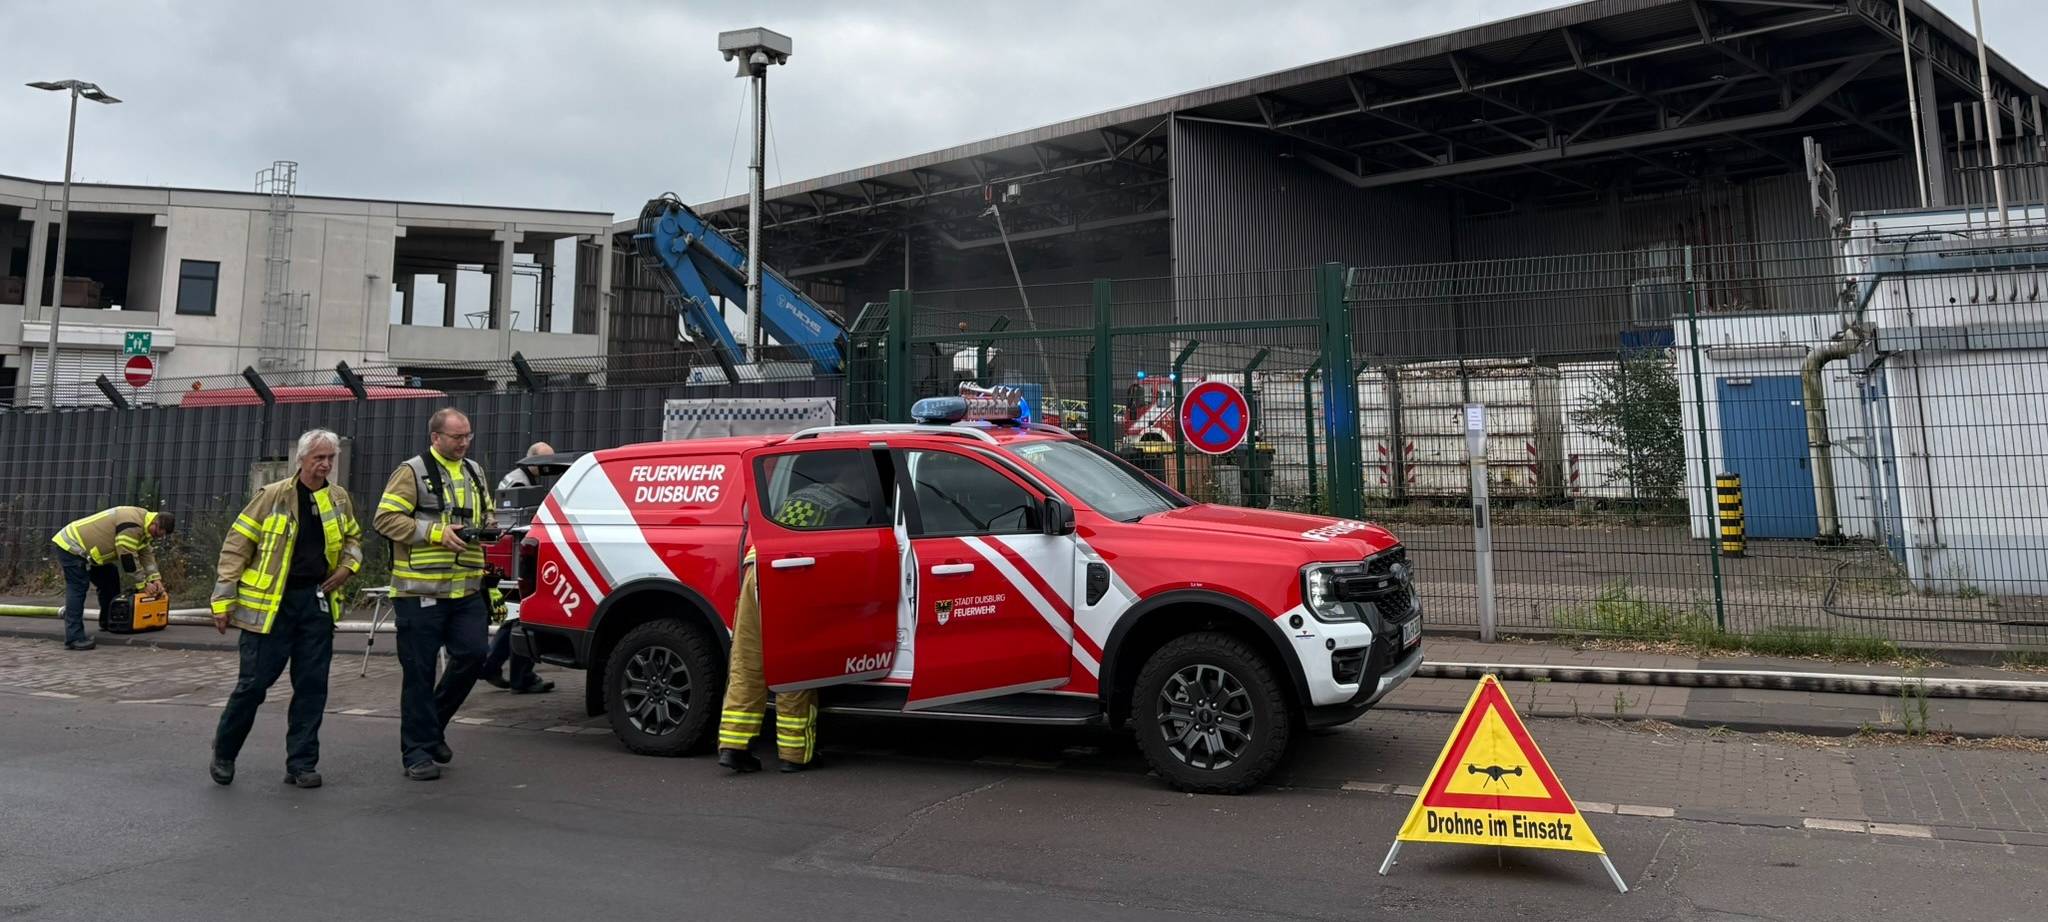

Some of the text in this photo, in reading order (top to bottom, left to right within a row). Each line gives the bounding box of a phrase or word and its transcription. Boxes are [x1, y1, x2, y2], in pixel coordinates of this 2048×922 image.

[785, 302, 821, 333] FUCHS
[629, 464, 726, 482] FEUERWEHR
[634, 485, 720, 503] DUISBURG
[552, 573, 581, 618] 112
[954, 593, 1006, 607] STADT DUISBURG
[953, 605, 996, 618] FEUERWEHR
[845, 651, 892, 674] KdoW
[1427, 810, 1573, 841] Drohne im Einsatz
